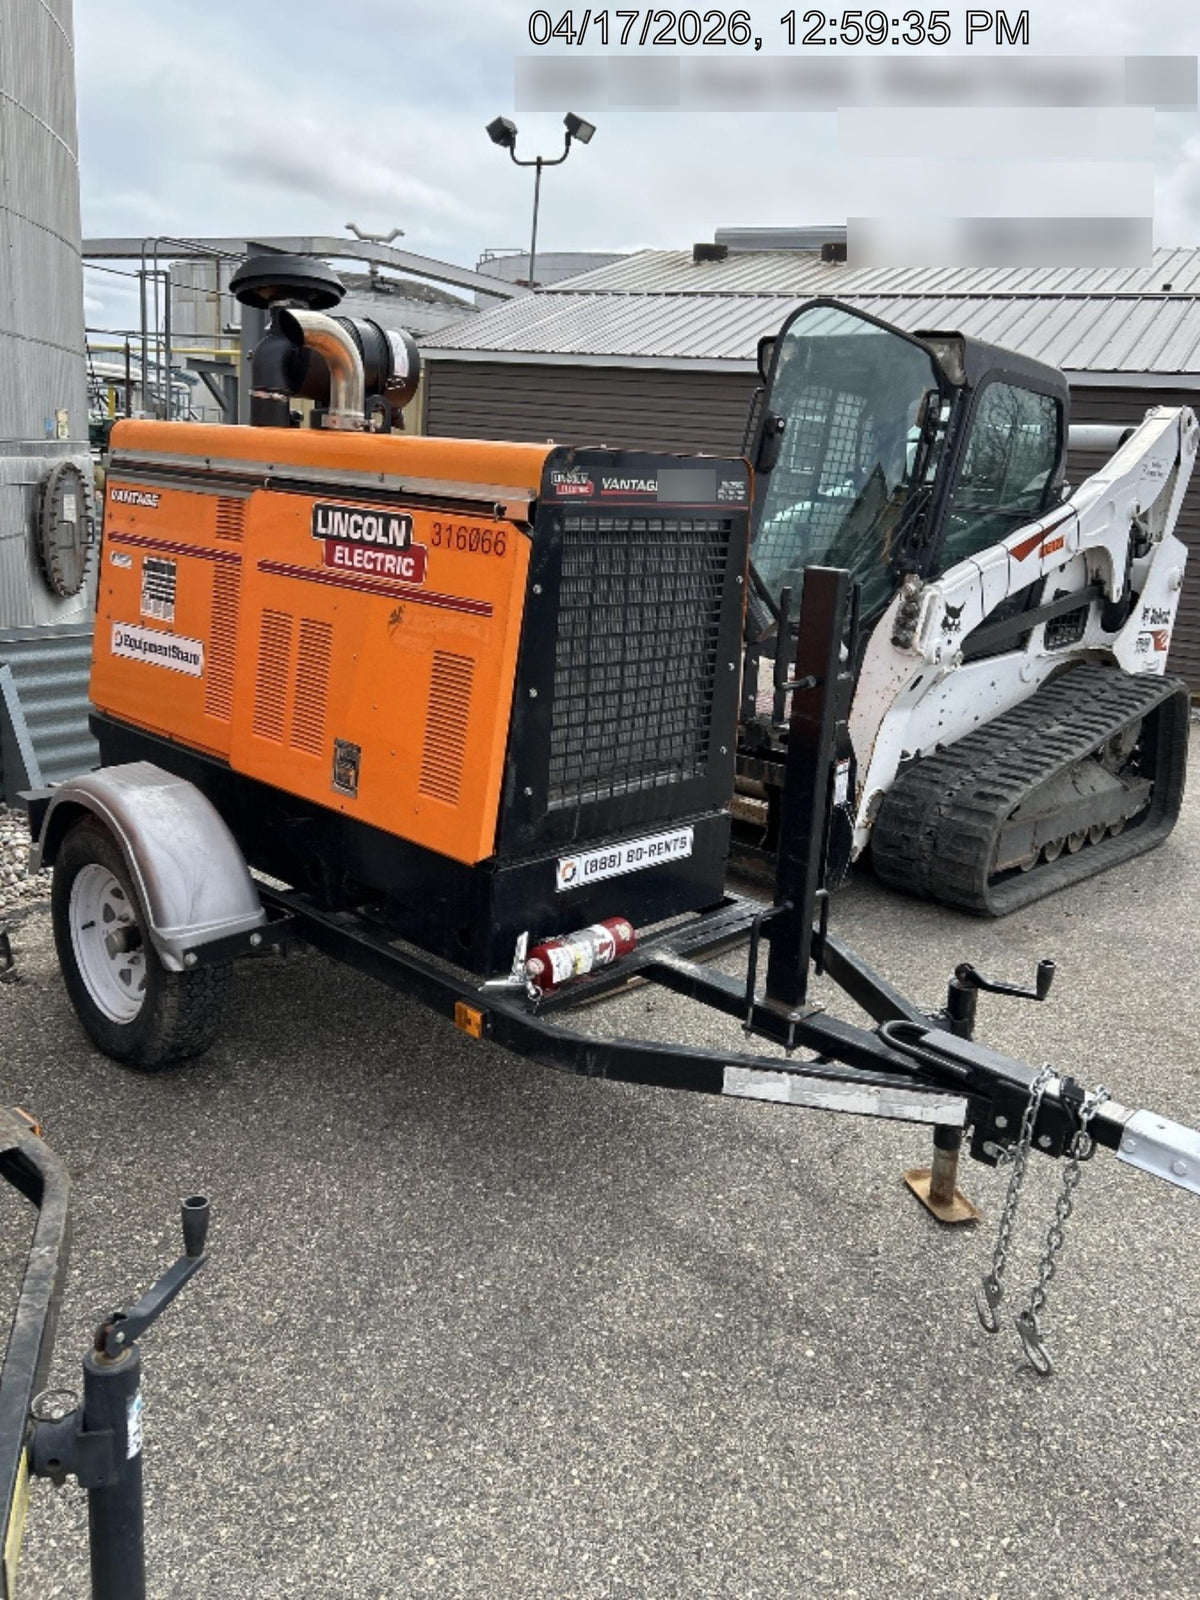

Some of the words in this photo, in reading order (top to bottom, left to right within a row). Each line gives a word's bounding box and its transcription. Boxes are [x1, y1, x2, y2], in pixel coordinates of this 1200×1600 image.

[110, 488, 161, 508] VANTAGE
[602, 477, 658, 492] VANTAG
[316, 508, 406, 547] LINCOLN
[431, 521, 507, 557] 316066
[333, 545, 415, 577] ELECTRIC
[123, 633, 201, 666] EquipmentShare
[584, 851, 622, 876] (888)
